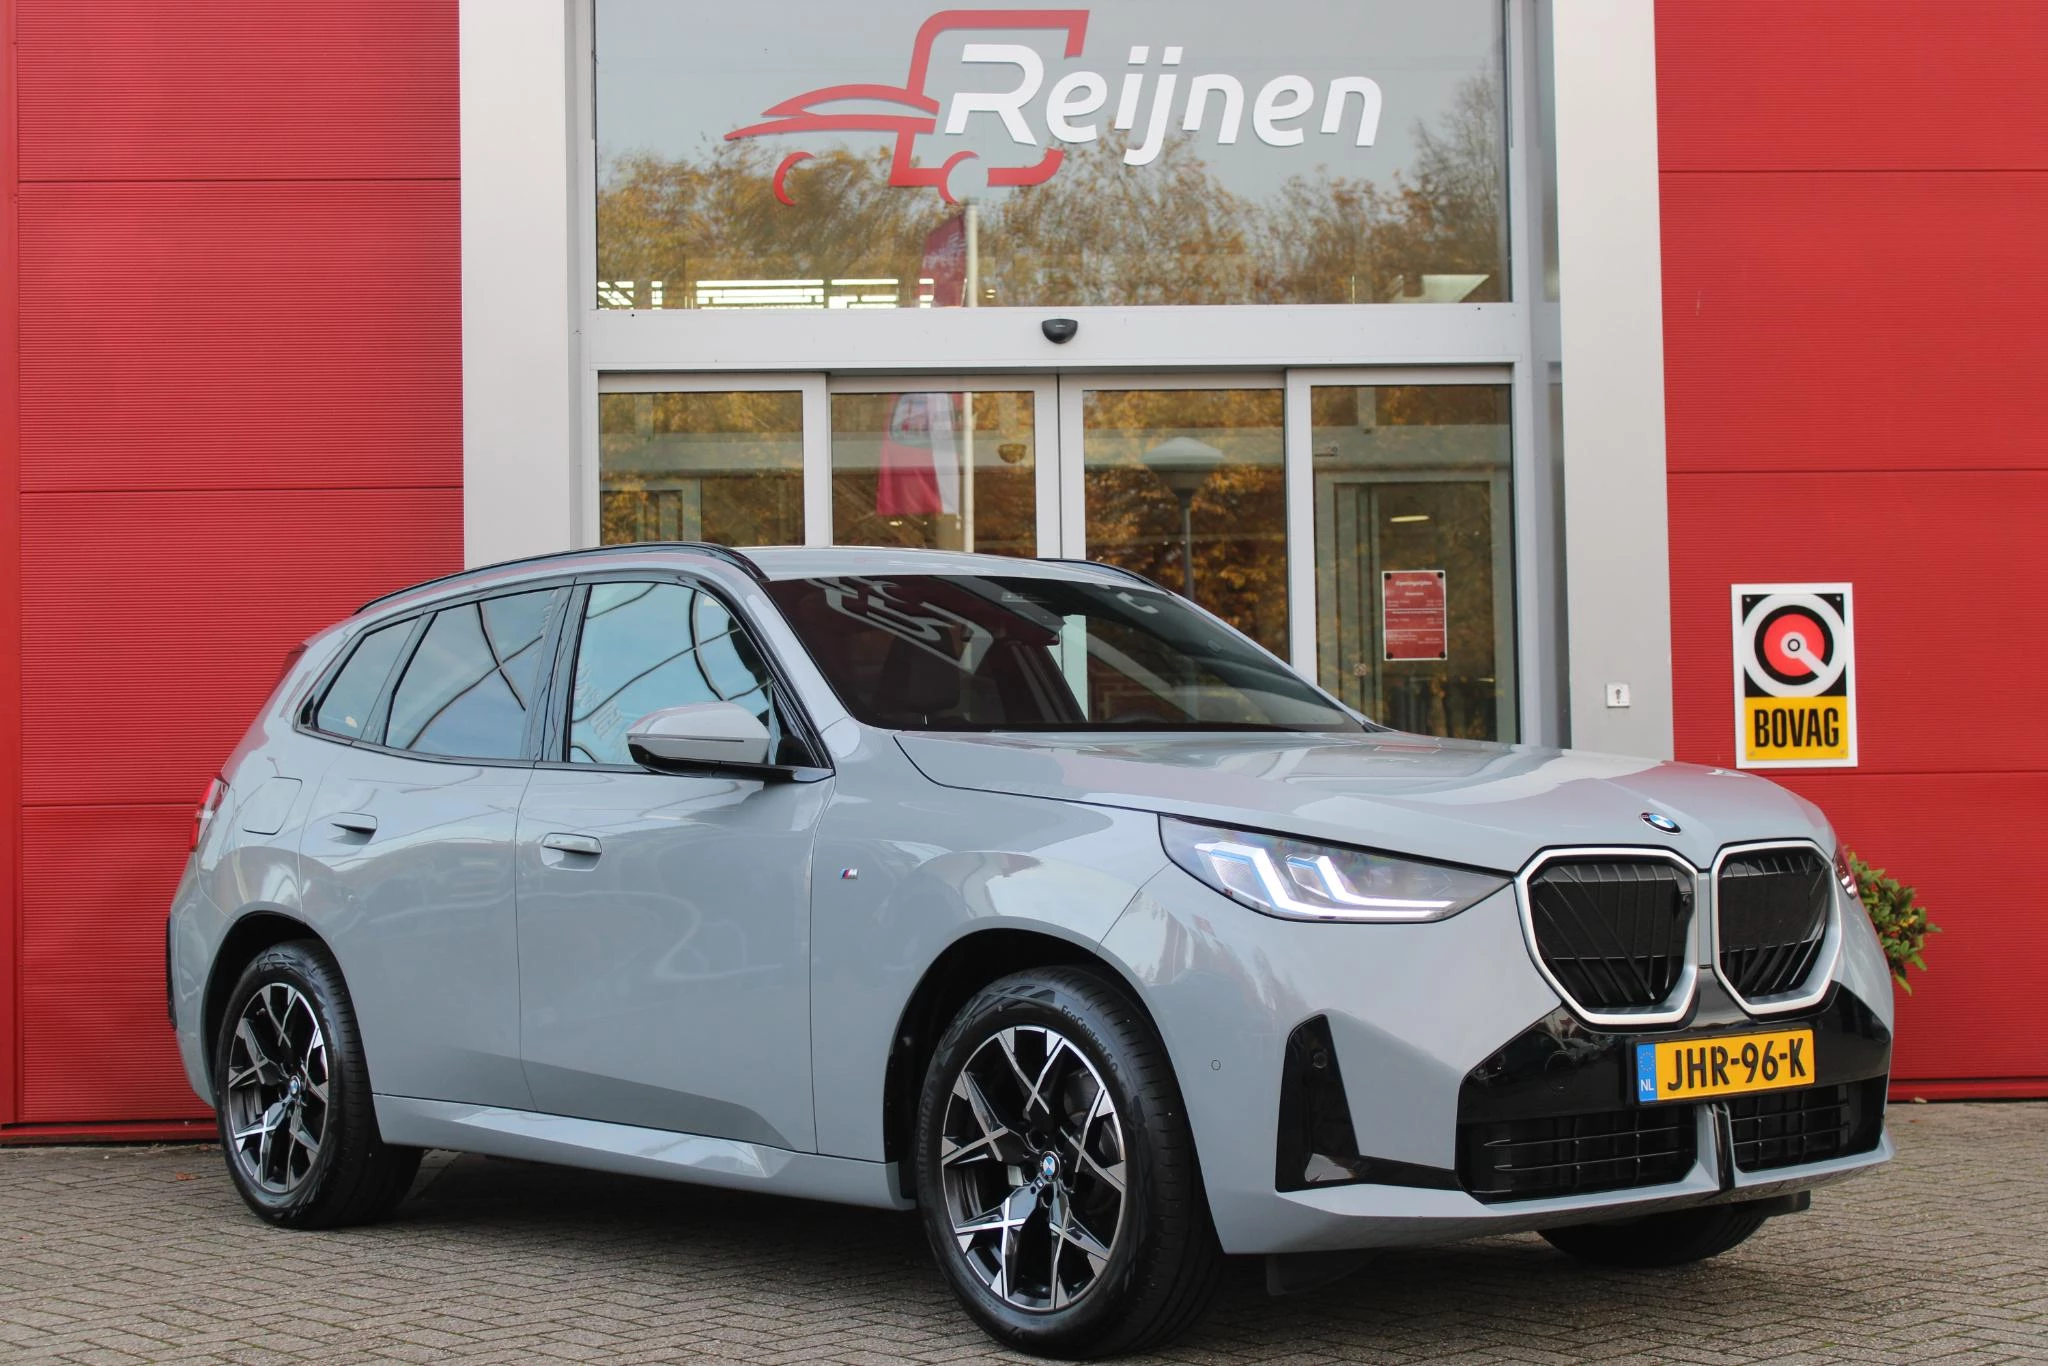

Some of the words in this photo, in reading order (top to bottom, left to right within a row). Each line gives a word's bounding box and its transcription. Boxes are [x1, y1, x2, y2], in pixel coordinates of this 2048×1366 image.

[944, 43, 1383, 166] Reijnen
[1753, 707, 1840, 749] BOVAG
[1640, 1079, 1654, 1092] NL
[1667, 1038, 1806, 1091] JHR-96-K
